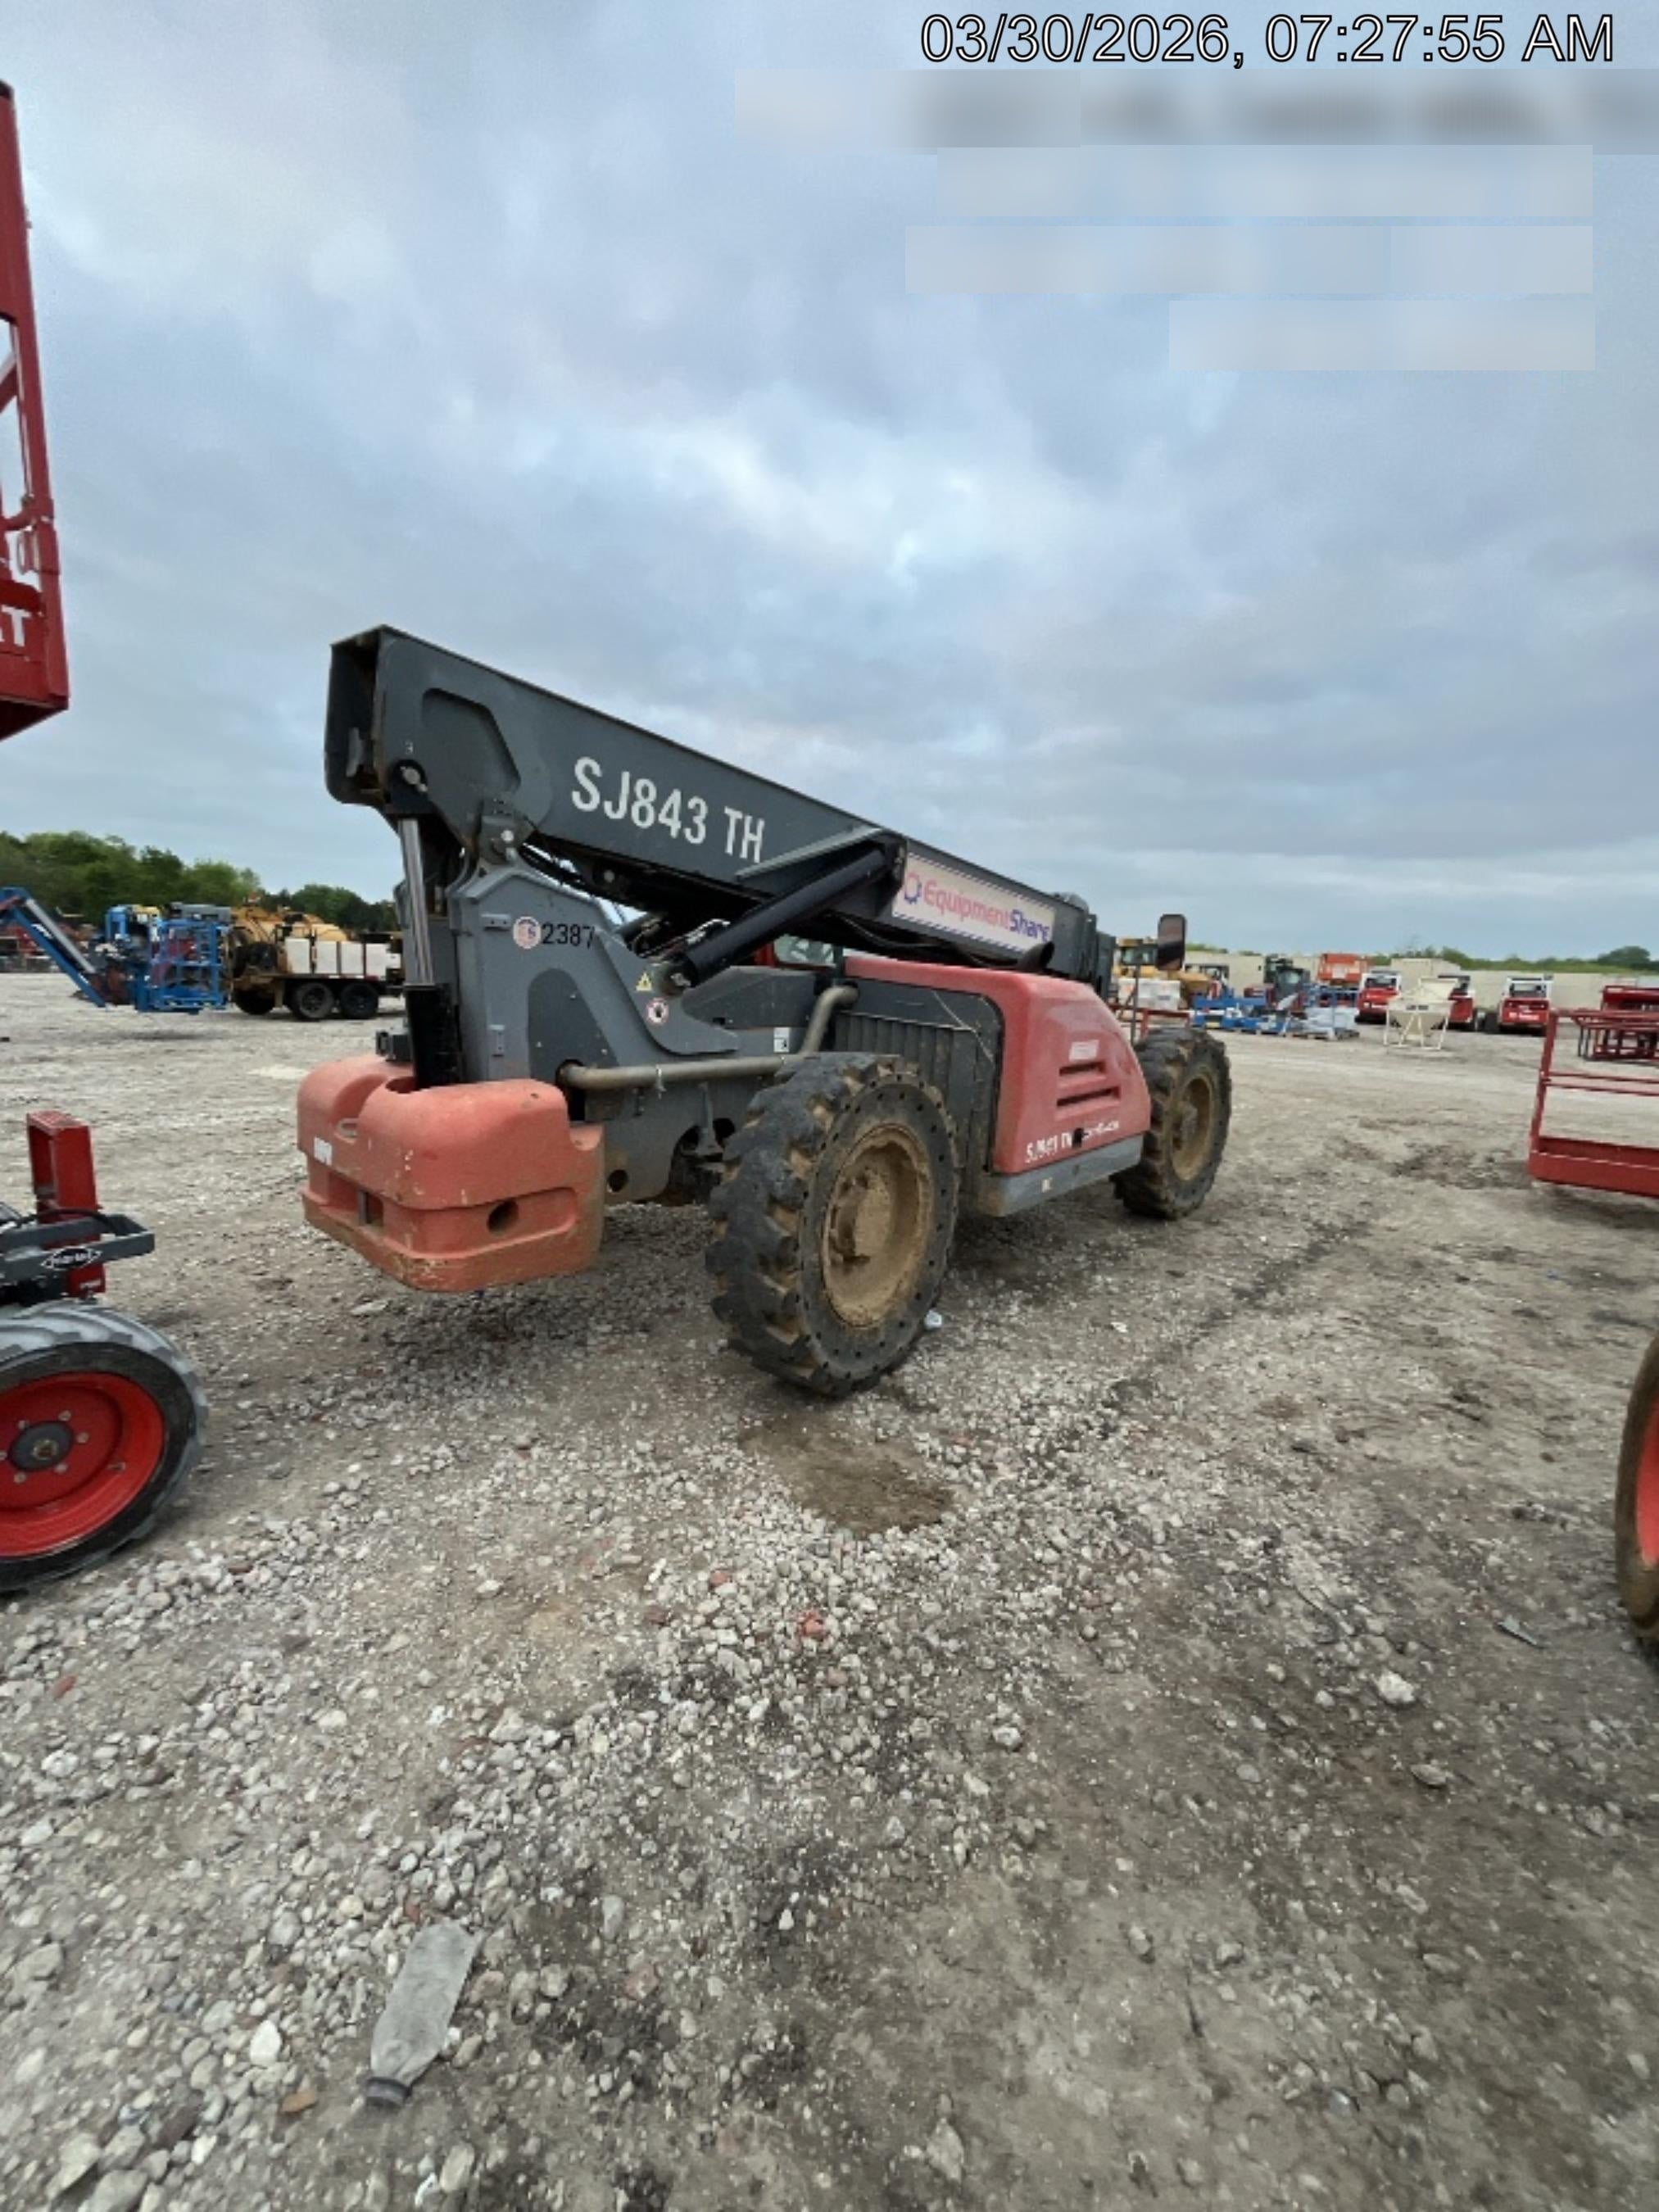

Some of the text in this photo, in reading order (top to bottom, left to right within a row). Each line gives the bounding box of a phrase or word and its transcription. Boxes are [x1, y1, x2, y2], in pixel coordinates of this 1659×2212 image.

[572, 756, 765, 863] SJ843 TH
[923, 879, 1050, 943] EquipmentShare
